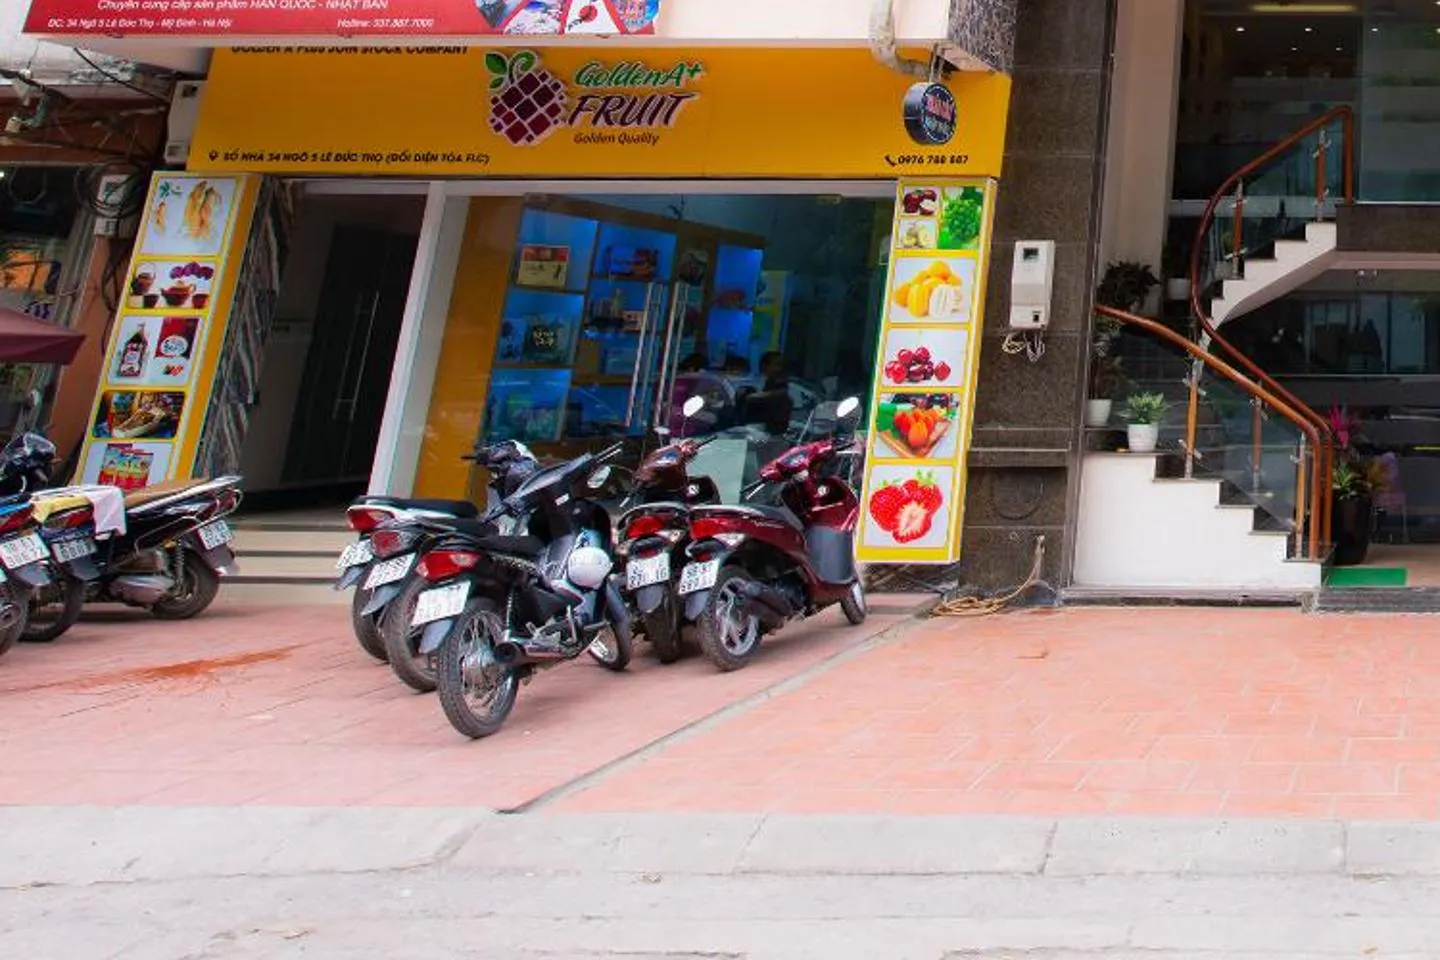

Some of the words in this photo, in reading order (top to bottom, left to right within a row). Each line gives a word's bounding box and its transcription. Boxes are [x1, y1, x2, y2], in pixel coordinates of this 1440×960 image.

[567, 93, 697, 127] FRUIT
[573, 132, 616, 144] Golden
[618, 132, 661, 146] Quality
